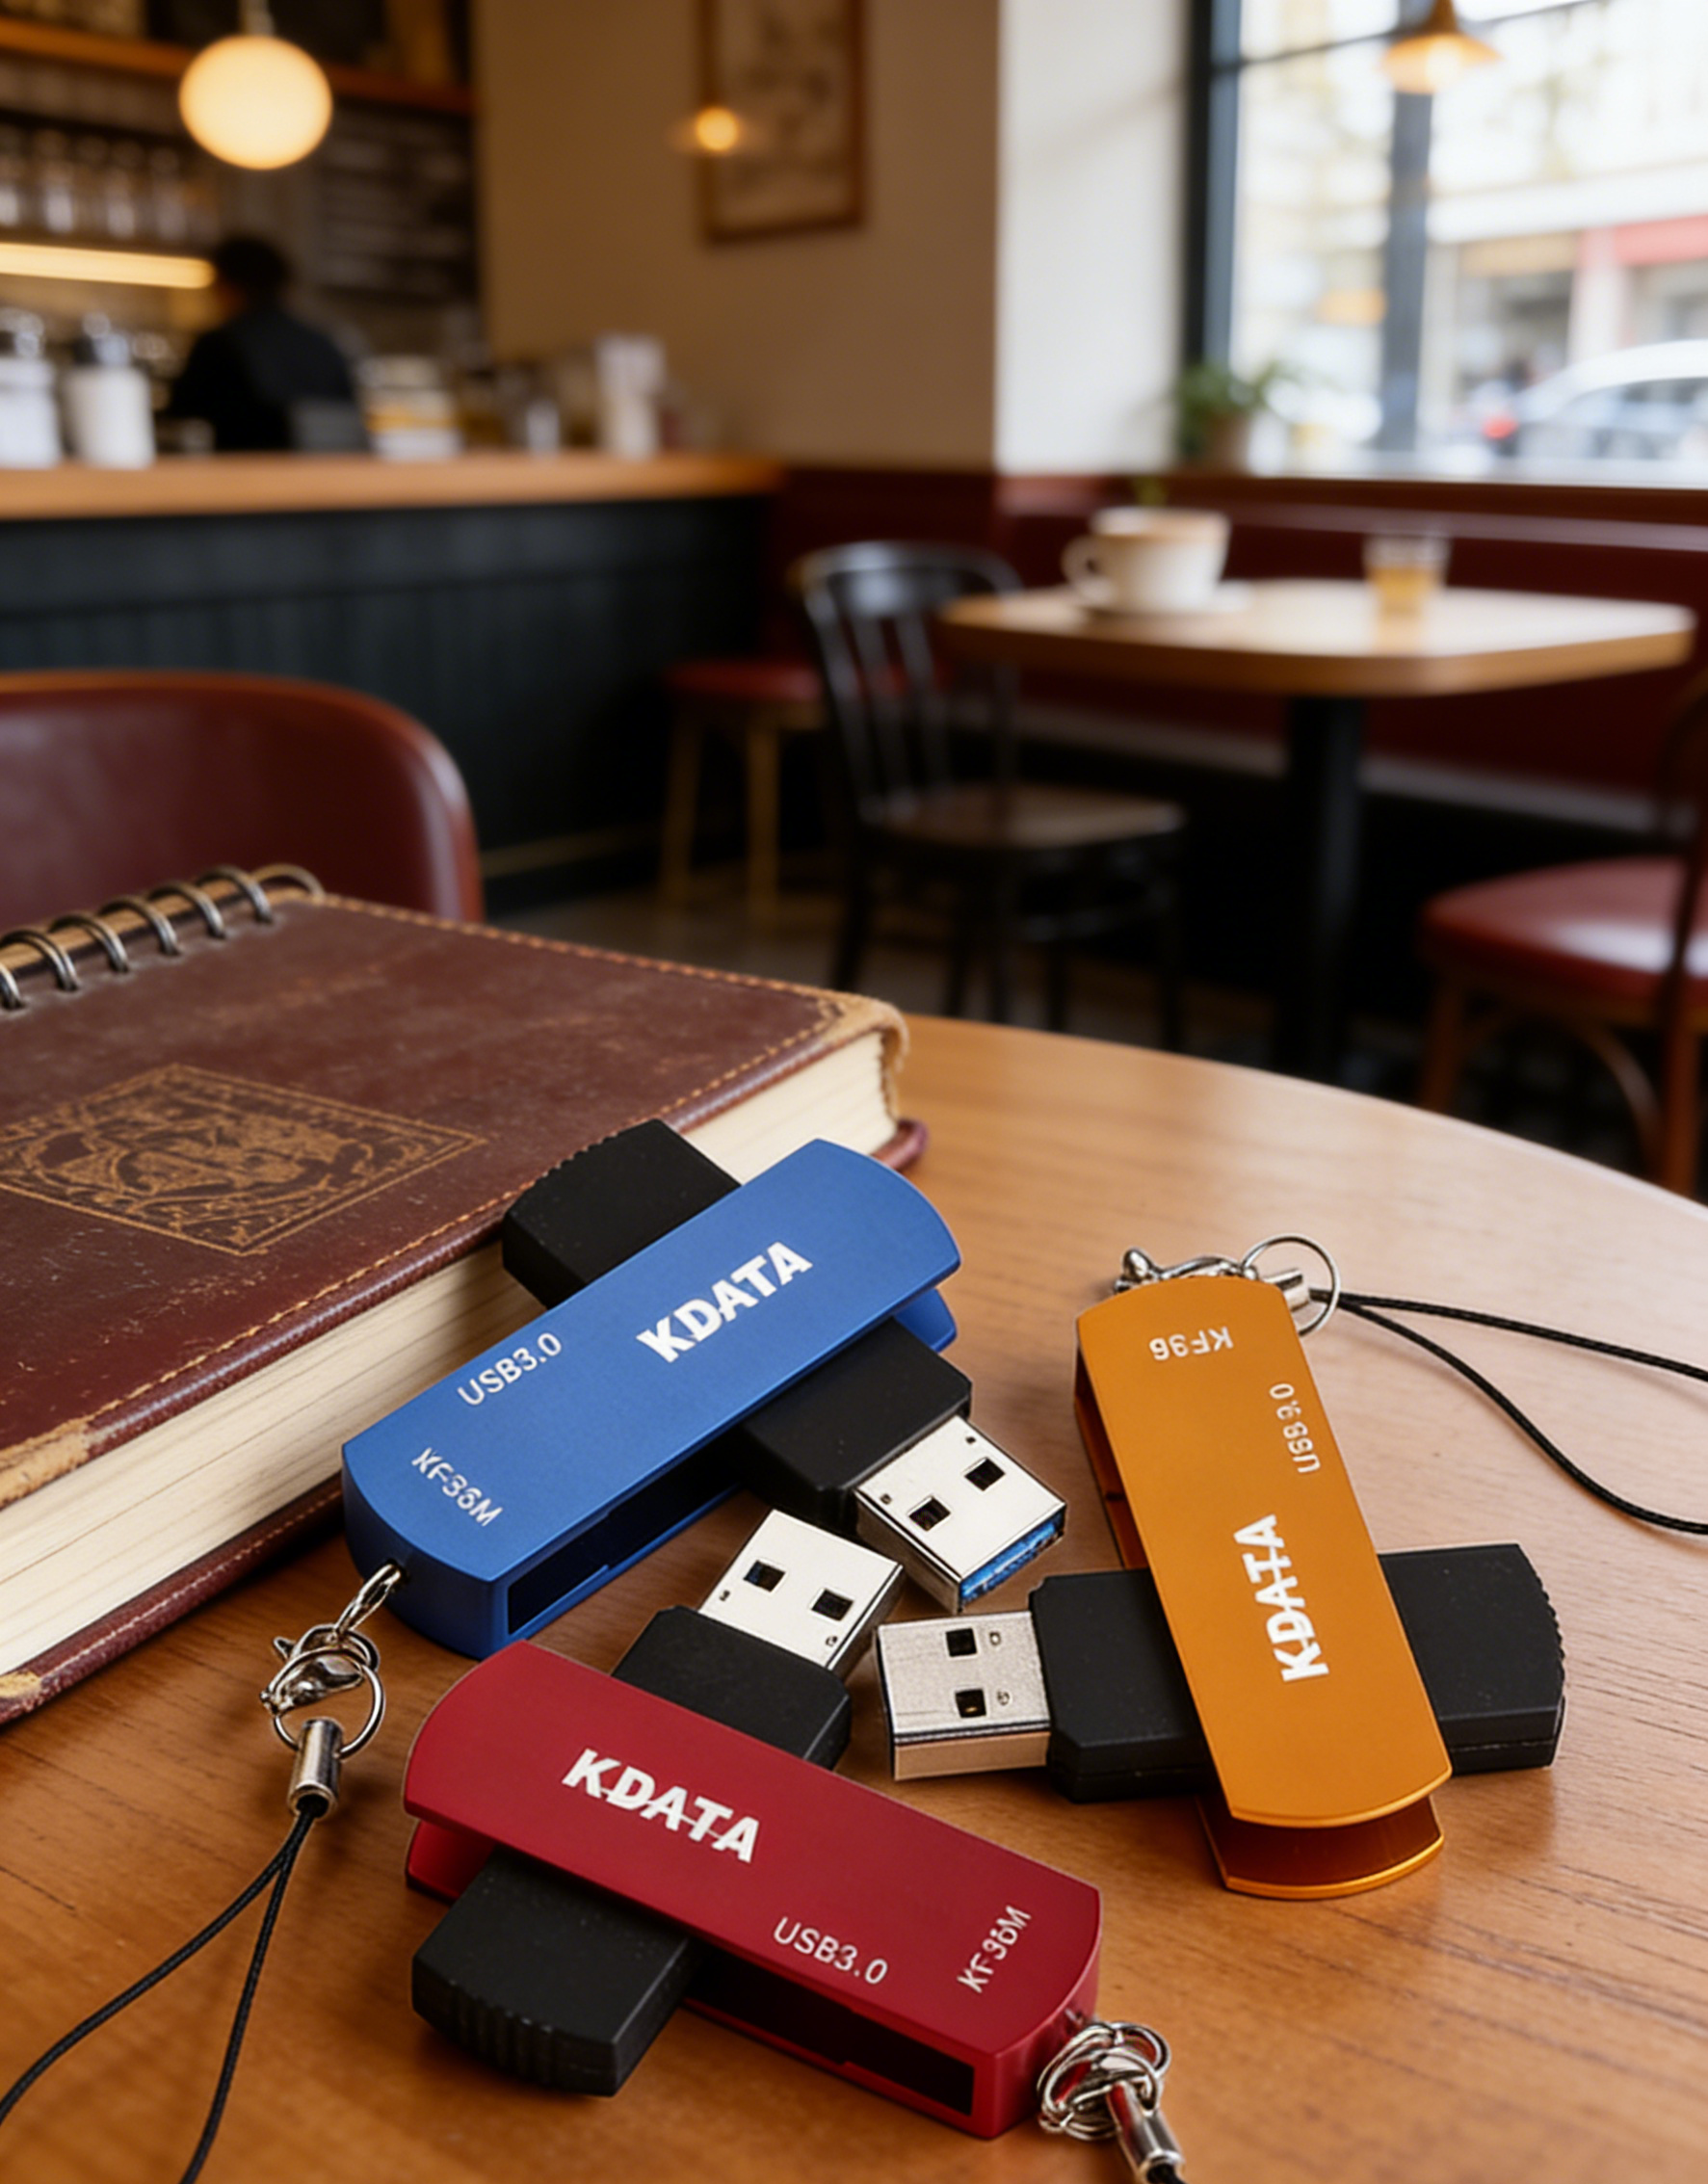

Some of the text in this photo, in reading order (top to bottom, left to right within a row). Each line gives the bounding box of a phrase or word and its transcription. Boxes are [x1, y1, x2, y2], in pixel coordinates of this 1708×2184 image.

[637, 1242, 813, 1363] KDATA
[458, 1332, 562, 1406] USB3.0
[411, 1447, 503, 1527] KF36M
[1233, 1513, 1329, 1681] KDATA
[562, 1749, 759, 1863] KDATA
[774, 1917, 888, 1985] USB3.0
